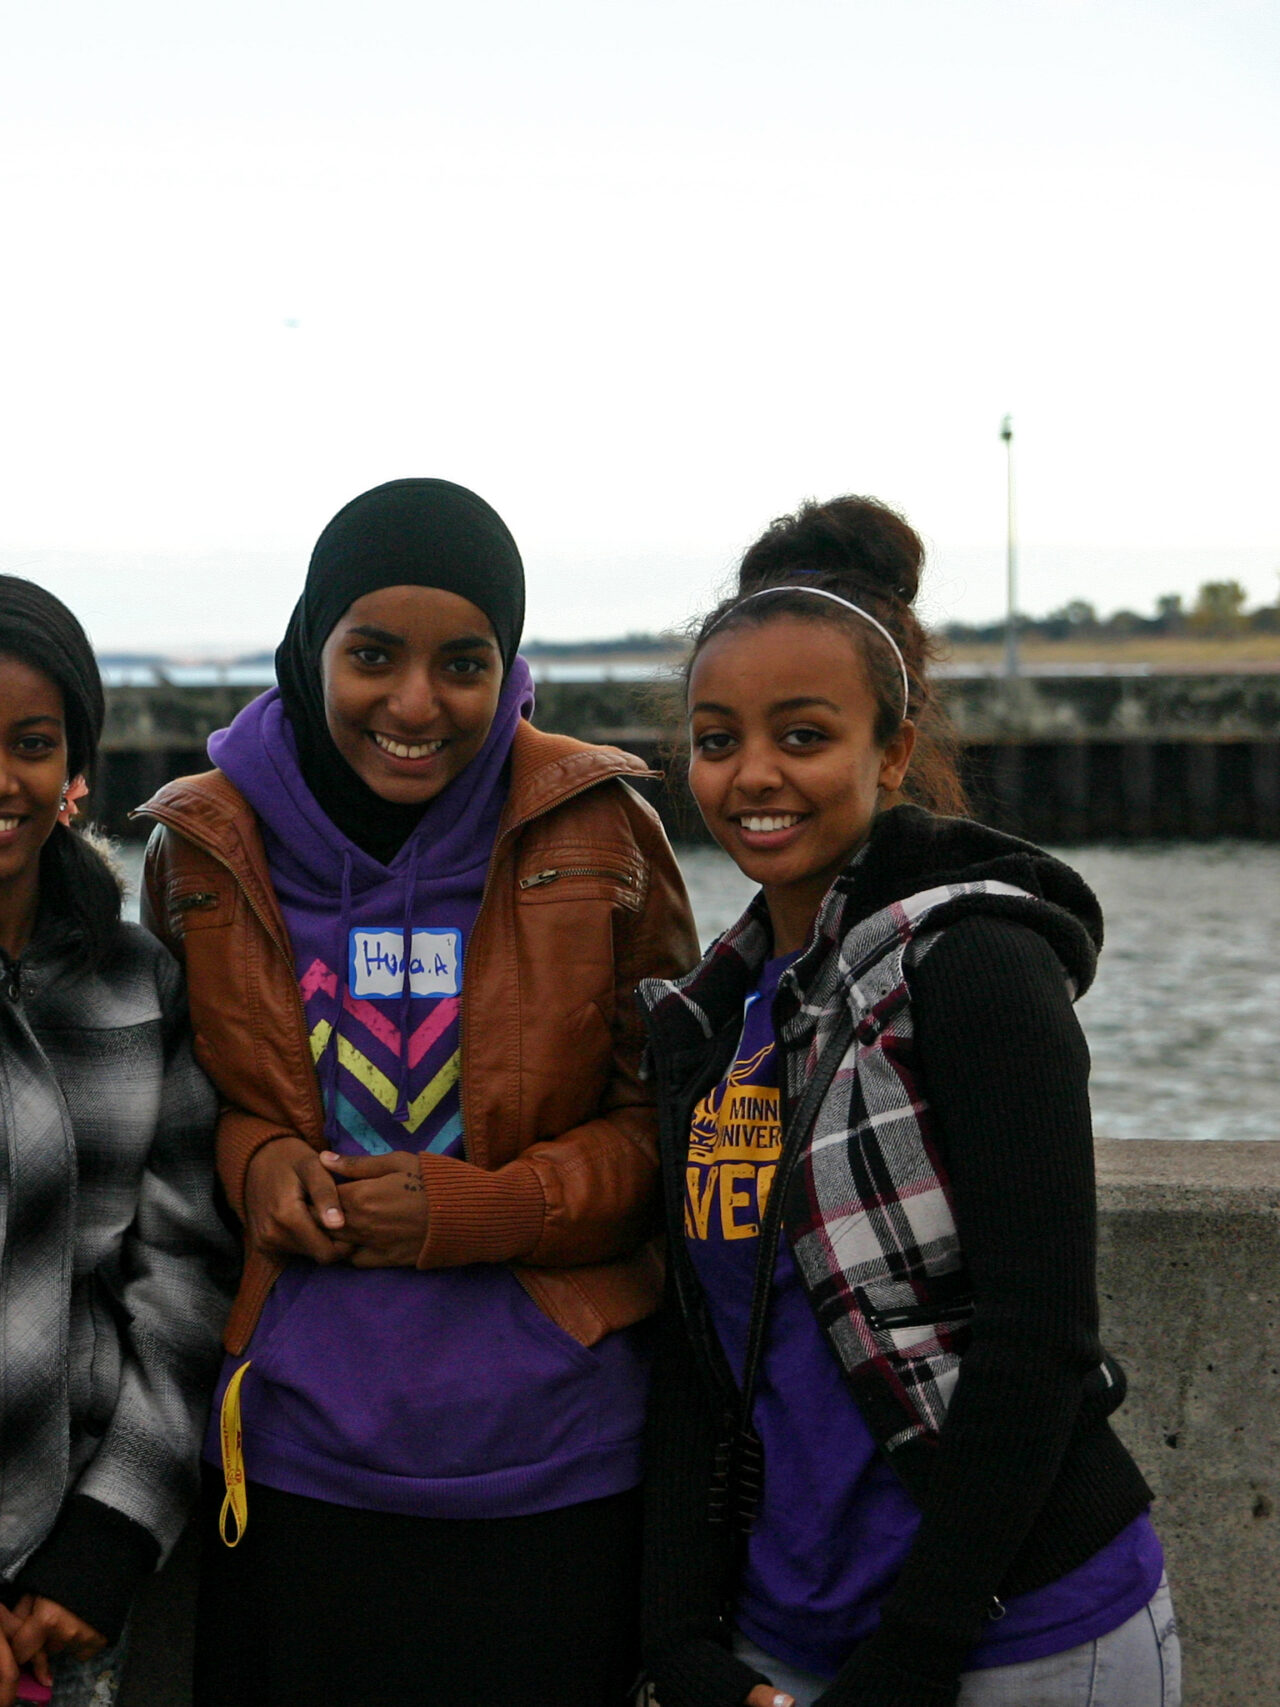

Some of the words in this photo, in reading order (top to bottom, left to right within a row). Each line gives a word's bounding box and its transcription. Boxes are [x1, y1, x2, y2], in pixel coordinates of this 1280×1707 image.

[729, 1097, 778, 1122] MINN
[717, 1124, 783, 1148] NIVER
[685, 1163, 776, 1241] VE
